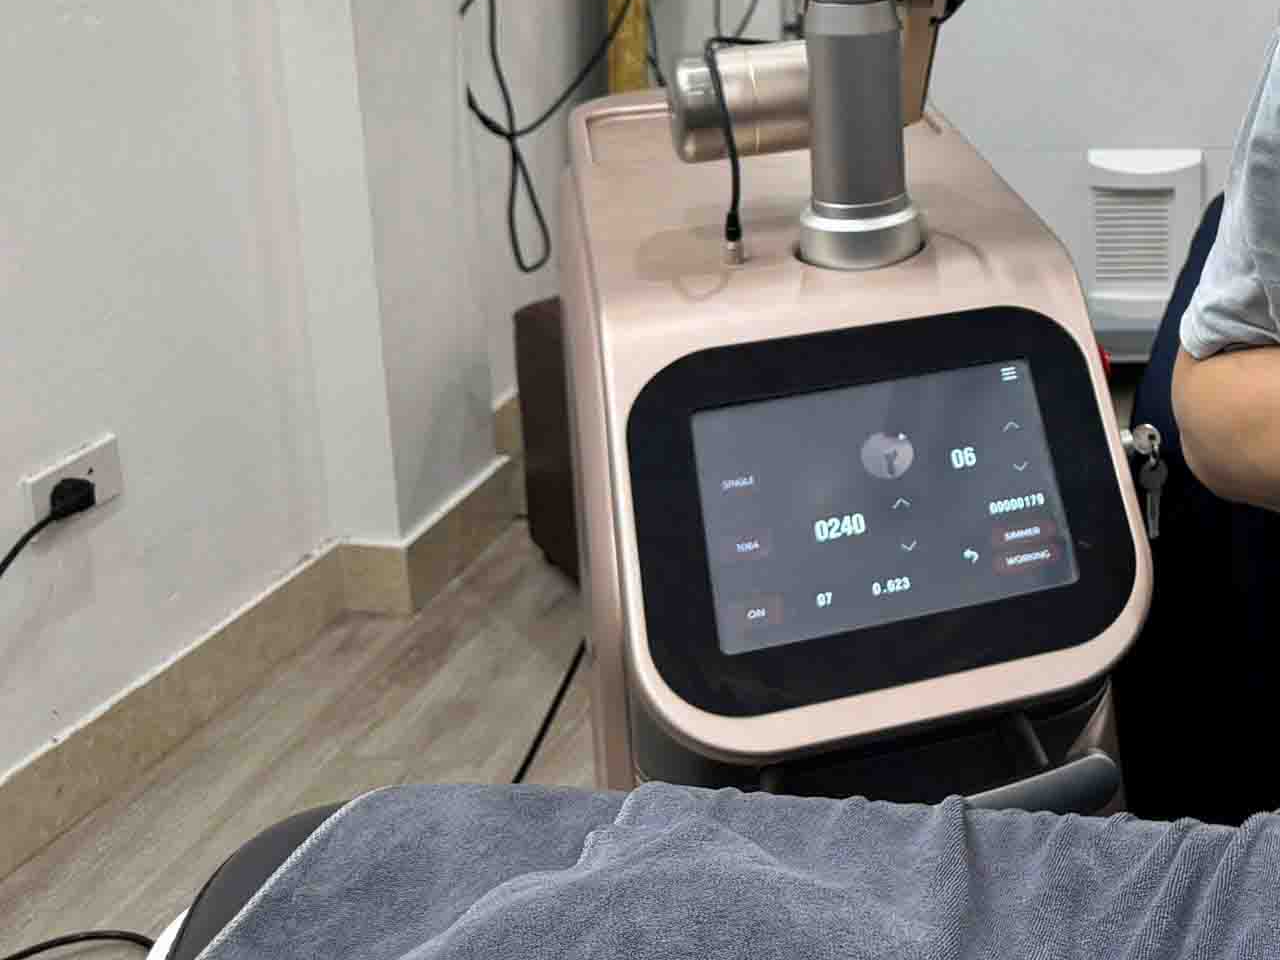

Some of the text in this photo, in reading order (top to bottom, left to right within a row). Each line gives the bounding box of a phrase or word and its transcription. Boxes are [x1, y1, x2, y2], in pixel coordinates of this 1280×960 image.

[951, 446, 977, 469] 06
[814, 512, 866, 542] 0240
[871, 576, 911, 597] 0.623
[815, 591, 833, 608] 07
[747, 607, 766, 620] ON
